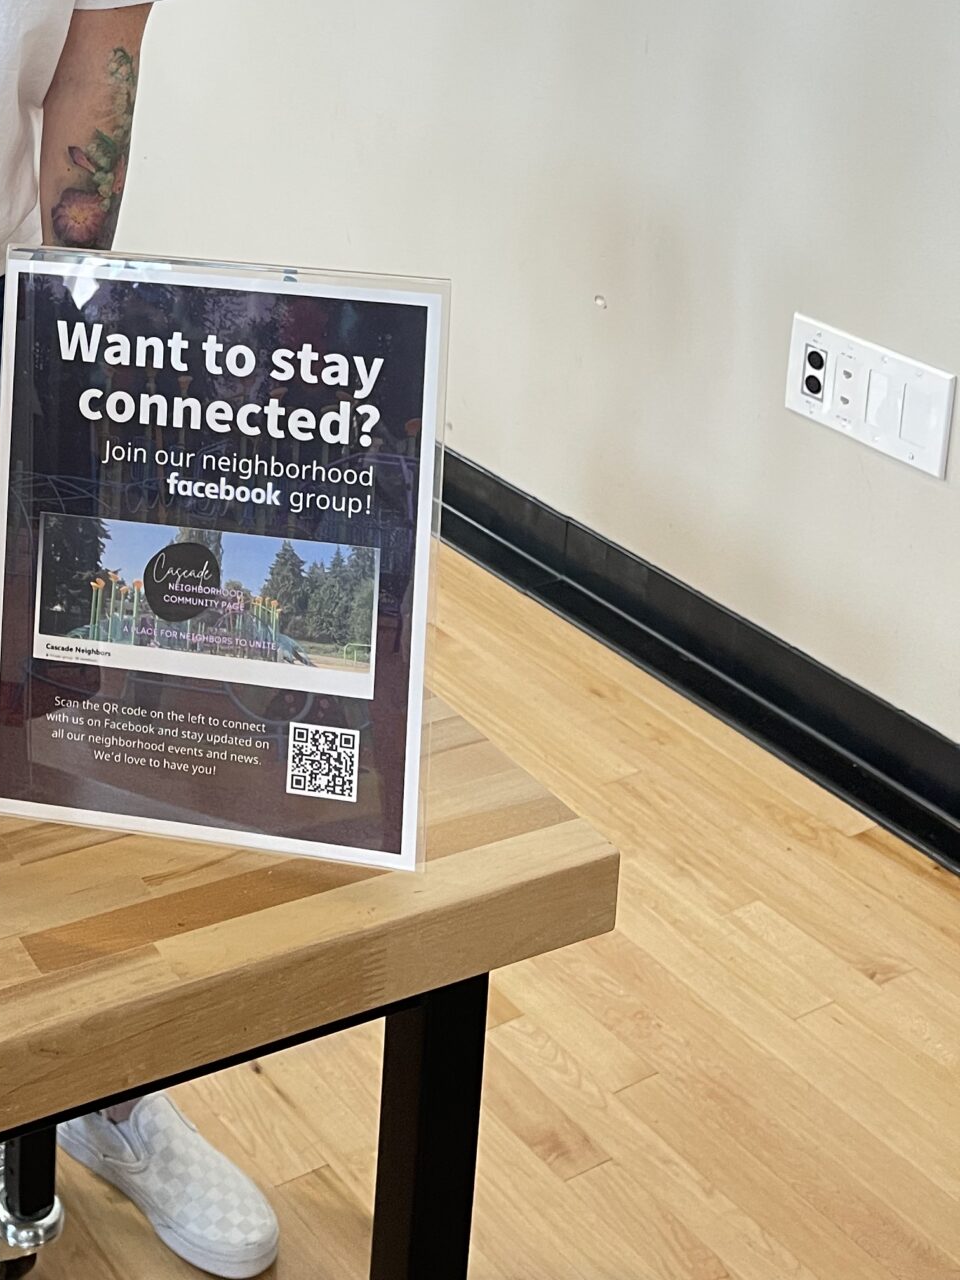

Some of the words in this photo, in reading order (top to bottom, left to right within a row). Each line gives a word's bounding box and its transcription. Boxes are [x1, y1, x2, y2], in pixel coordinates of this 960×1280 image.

[57, 320, 189, 372] Want
[202, 334, 256, 378] to
[270, 343, 384, 400] stay
[78, 388, 380, 448] connected?
[102, 440, 146, 464] Join
[154, 449, 195, 468] our
[202, 453, 374, 488] neighborhood
[166, 472, 280, 506] facebook
[290, 490, 372, 518] group!
[153, 552, 212, 586] Cascade
[163, 594, 219, 608] COMMUNITY
[222, 600, 244, 612] PAGE
[168, 582, 244, 598] NEIGHBORHOOD
[46, 642, 74, 652] Cascade
[75, 646, 111, 656] Neighbors
[160, 630, 178, 640] FOR
[180, 632, 233, 645] NEIGHBORS
[235, 638, 246, 646] TO
[248, 640, 276, 650] UNITE
[46, 712, 68, 722] with
[72, 716, 84, 725] us
[87, 718, 100, 727] on
[104, 718, 155, 734] Facebook
[158, 727, 178, 737] and
[181, 730, 204, 743] stay
[206, 734, 252, 748] updated
[255, 740, 270, 750] on
[54, 696, 79, 708] Scan
[82, 700, 100, 710] the
[102, 702, 118, 714] QR
[122, 706, 147, 717] code
[150, 710, 164, 720] on
[168, 710, 184, 722] the
[188, 712, 205, 724] left
[208, 716, 220, 726] to
[222, 720, 266, 733] connect
[52, 728, 64, 738] all
[66, 732, 86, 742] our
[88, 734, 164, 752] neighborhood
[168, 744, 204, 757] events
[206, 750, 227, 760] and
[230, 753, 262, 766] news.
[94, 750, 121, 762] We'd
[124, 754, 146, 766] love
[150, 758, 160, 768] to
[164, 758, 189, 772] have
[192, 764, 216, 776] you!
